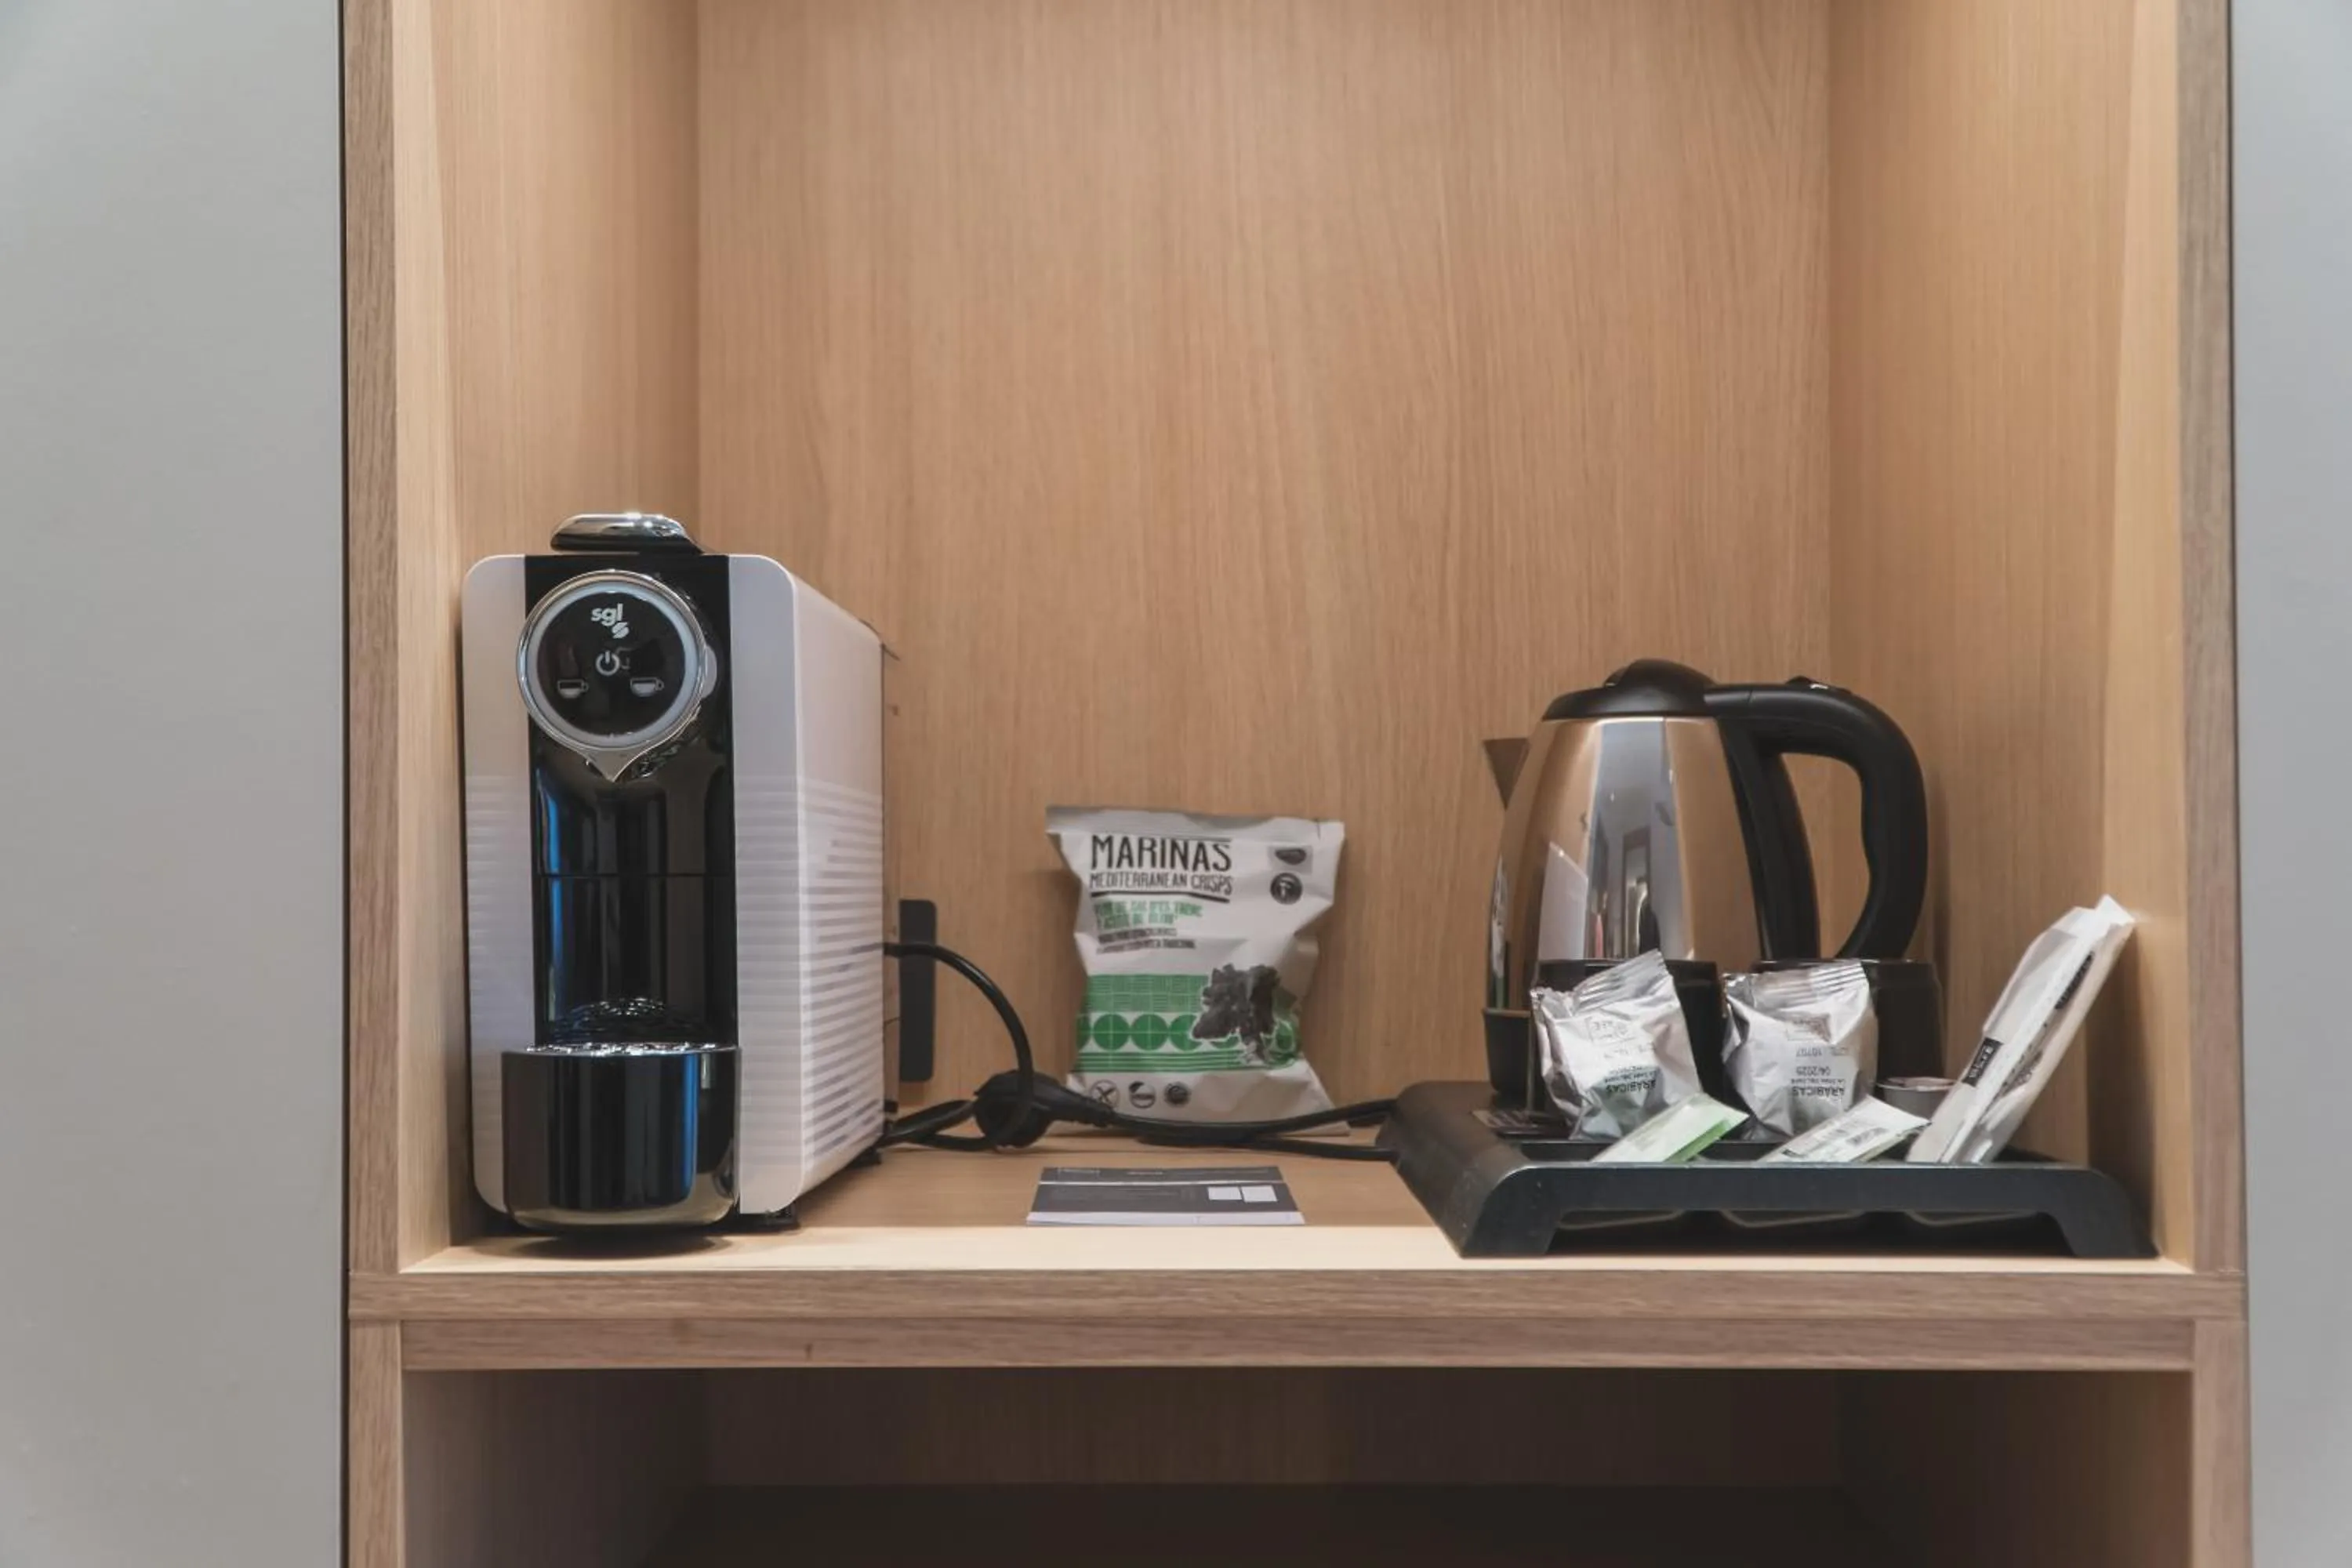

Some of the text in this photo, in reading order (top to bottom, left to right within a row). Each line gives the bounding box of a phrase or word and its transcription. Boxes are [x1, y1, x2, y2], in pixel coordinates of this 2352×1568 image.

[591, 603, 623, 626] sgl
[1091, 835, 1232, 873] MARINAS
[1090, 871, 1233, 895] MEDITERRANEAN CRISPS
[1791, 1086, 1845, 1097] ARABICAS
